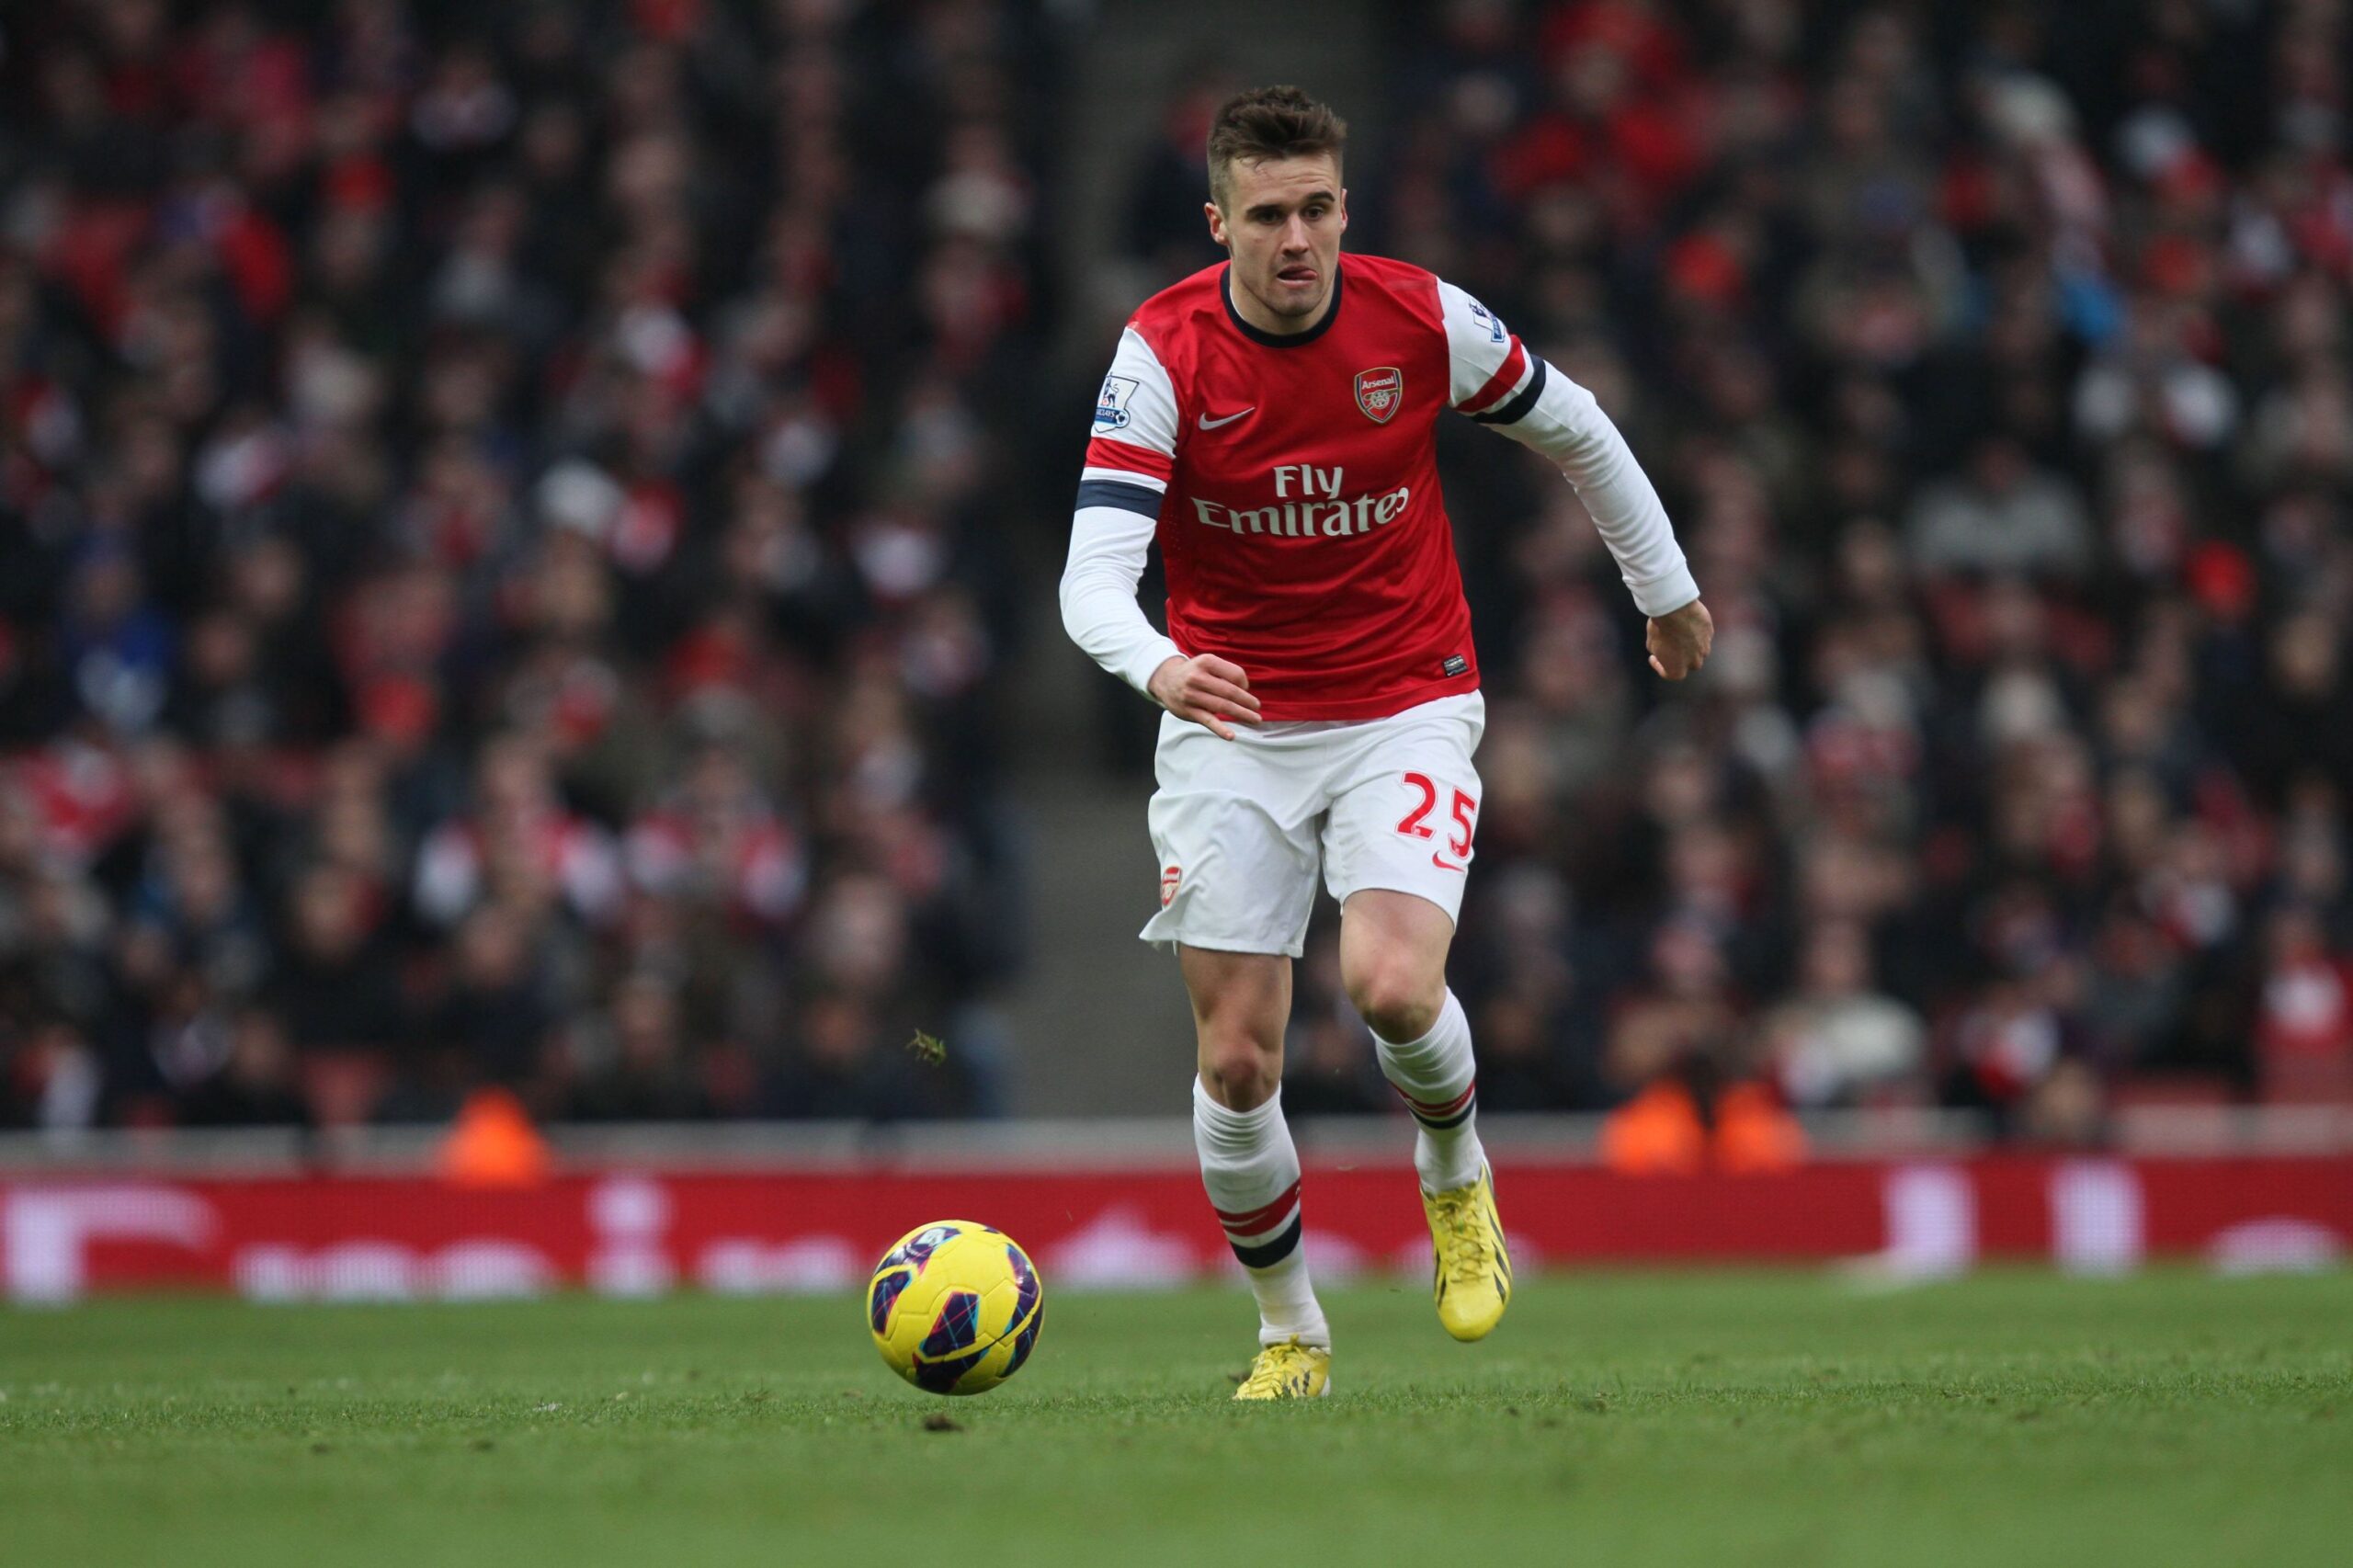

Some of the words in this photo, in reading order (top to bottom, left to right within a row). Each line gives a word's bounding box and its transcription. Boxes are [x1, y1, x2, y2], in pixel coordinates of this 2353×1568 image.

[1361, 376, 1395, 390] Arsenal
[1273, 464, 1344, 499] Fly
[1190, 487, 1410, 537] Emirates
[1395, 771, 1476, 859] 25
